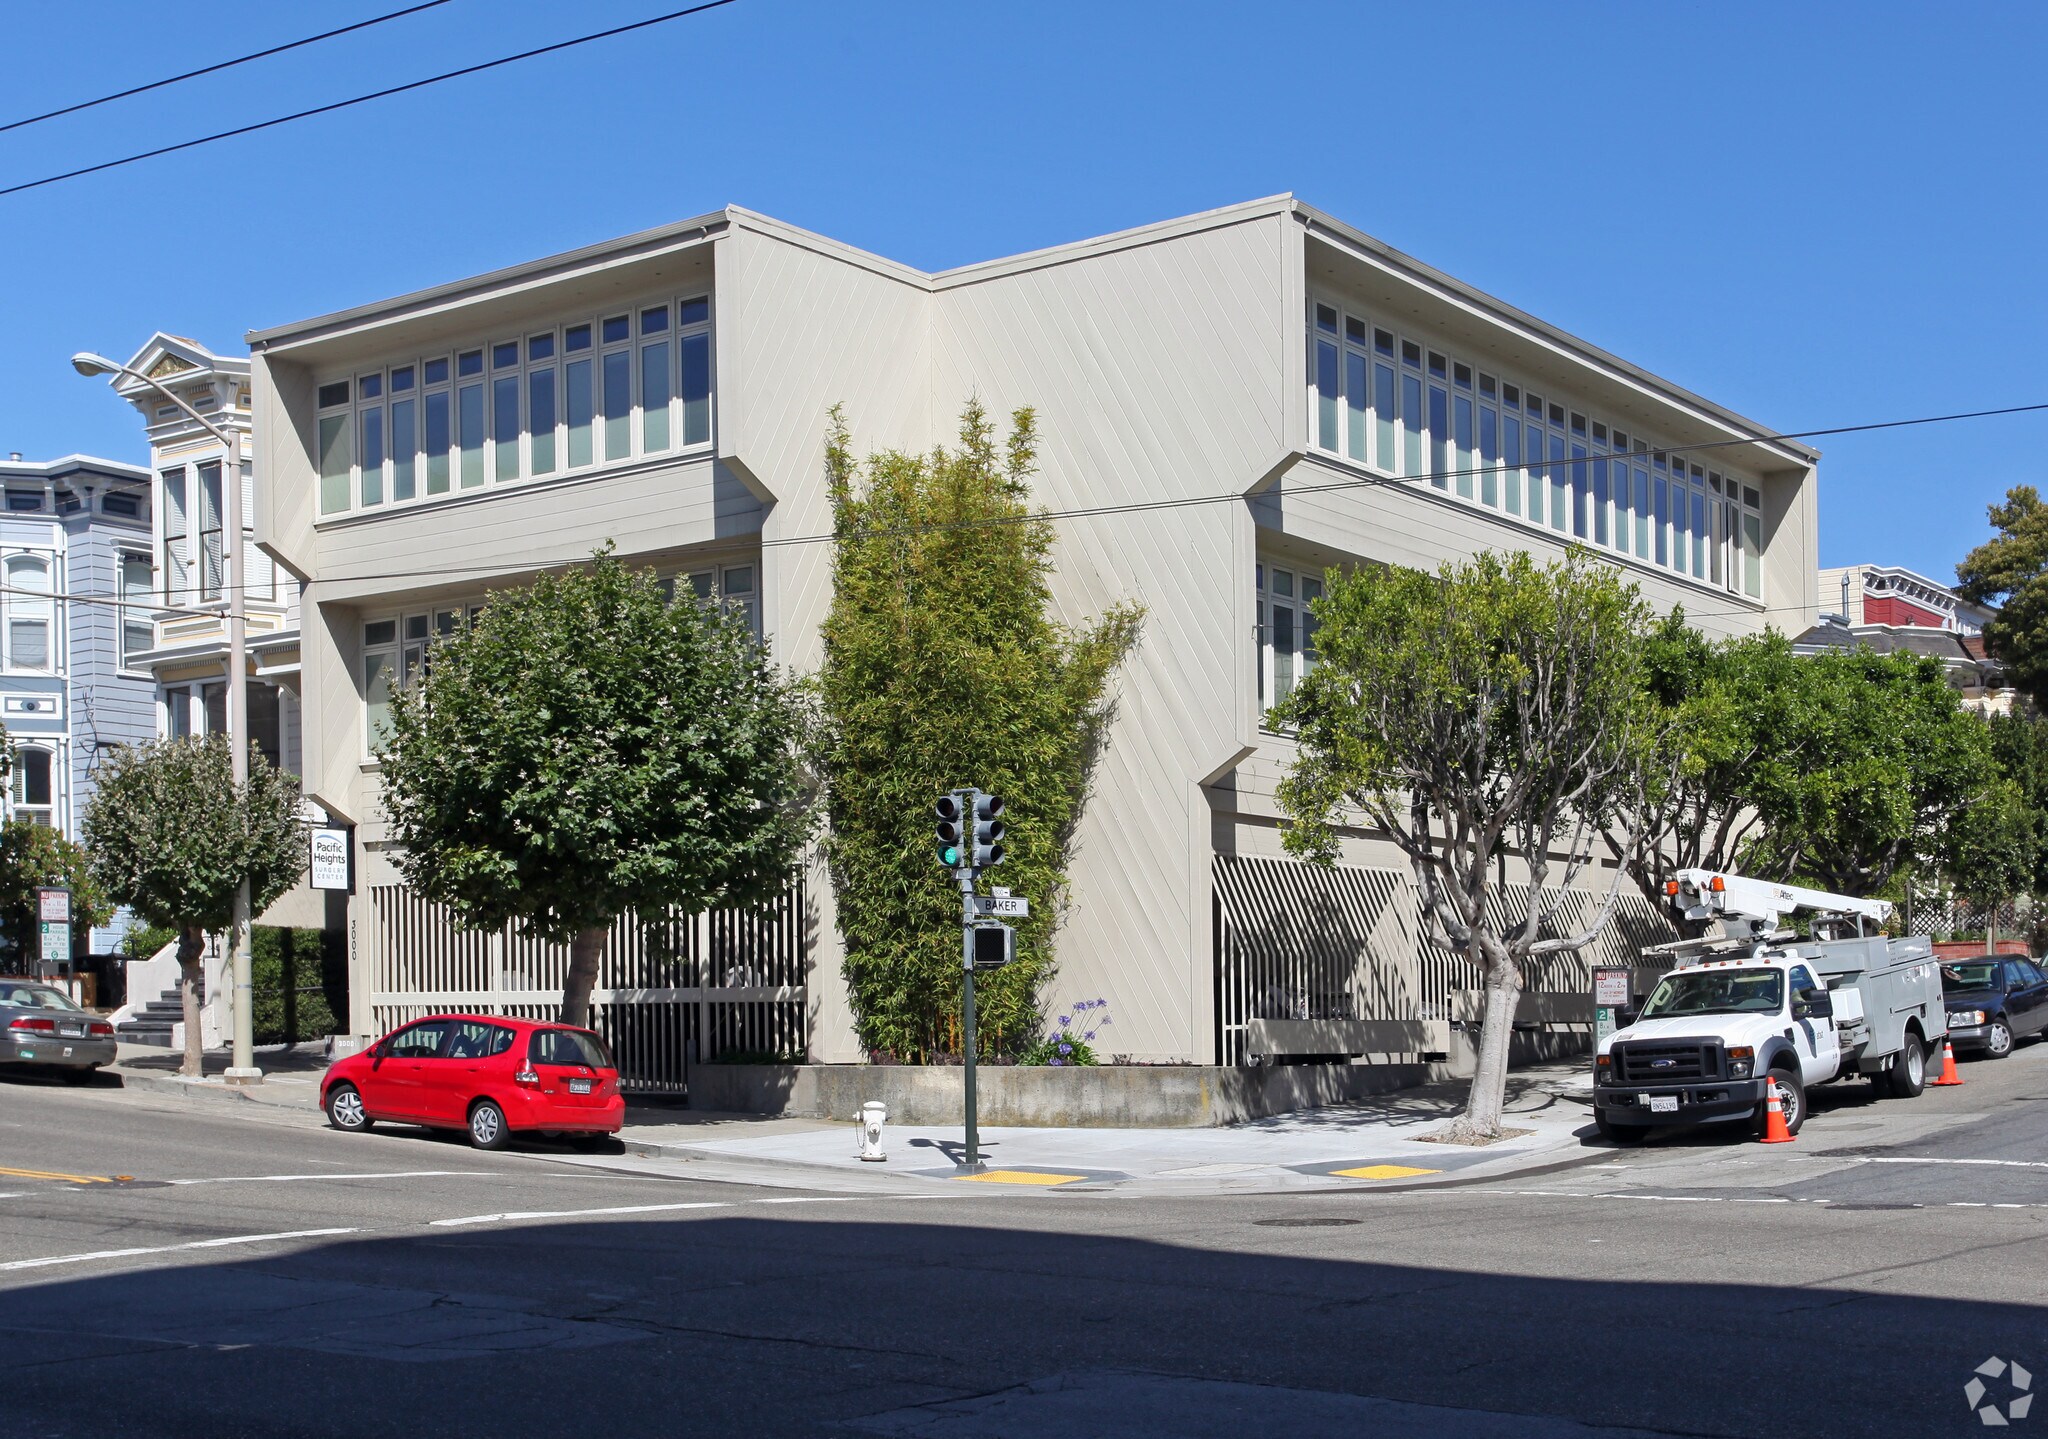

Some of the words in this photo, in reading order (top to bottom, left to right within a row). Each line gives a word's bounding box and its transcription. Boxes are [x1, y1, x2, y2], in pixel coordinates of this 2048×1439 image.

[316, 841, 343, 853] Pacific
[313, 852, 346, 865] Heights
[985, 900, 1017, 911] BAKER
[41, 924, 48, 933] 2
[1597, 971, 1606, 980] NO
[1606, 971, 1628, 979] PARKING
[1599, 1010, 1606, 1020] 2
